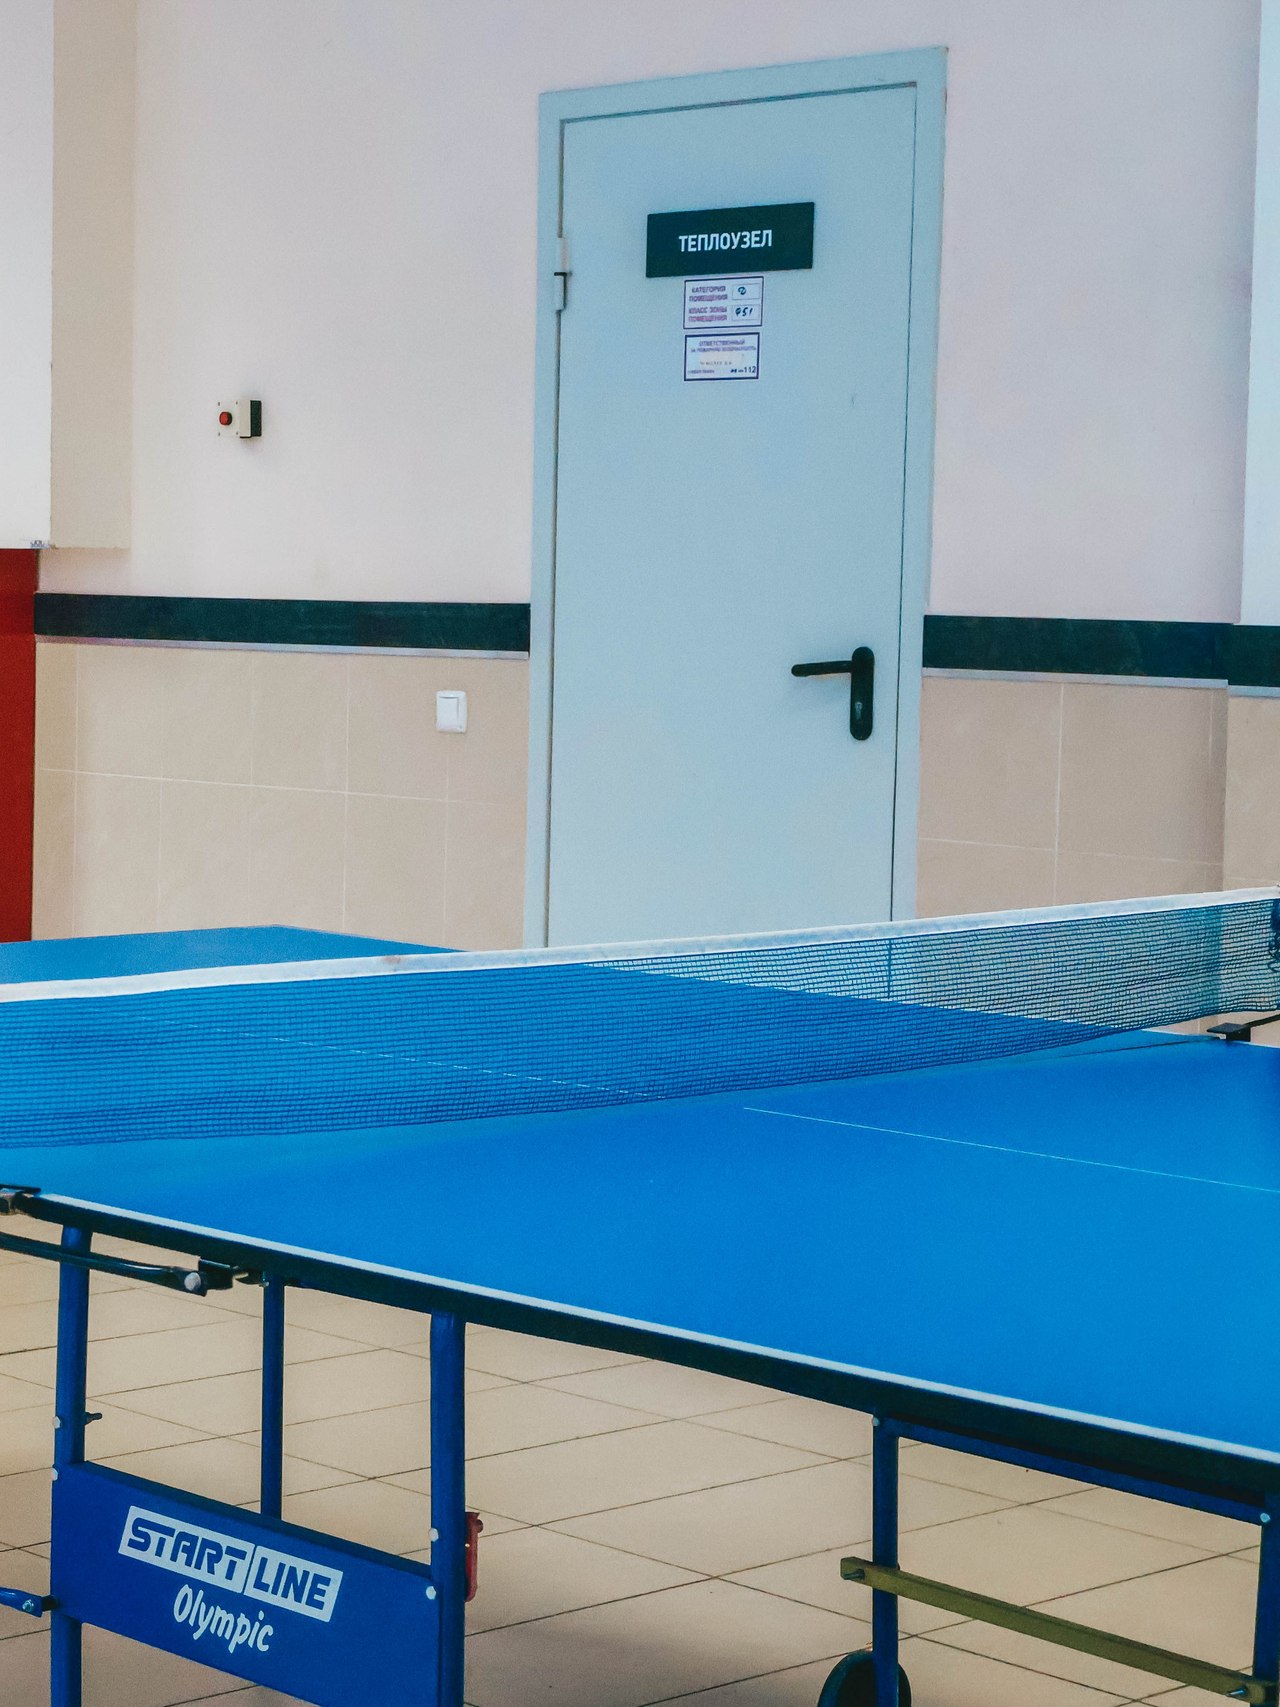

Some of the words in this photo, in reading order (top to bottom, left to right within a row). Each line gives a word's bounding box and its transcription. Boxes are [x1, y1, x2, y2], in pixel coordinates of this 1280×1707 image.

[679, 229, 773, 252] ТЕПЛОУЗЕЛ
[126, 1516, 248, 1582] START
[253, 1556, 333, 1611] LINE
[173, 1584, 275, 1654] Olympic
